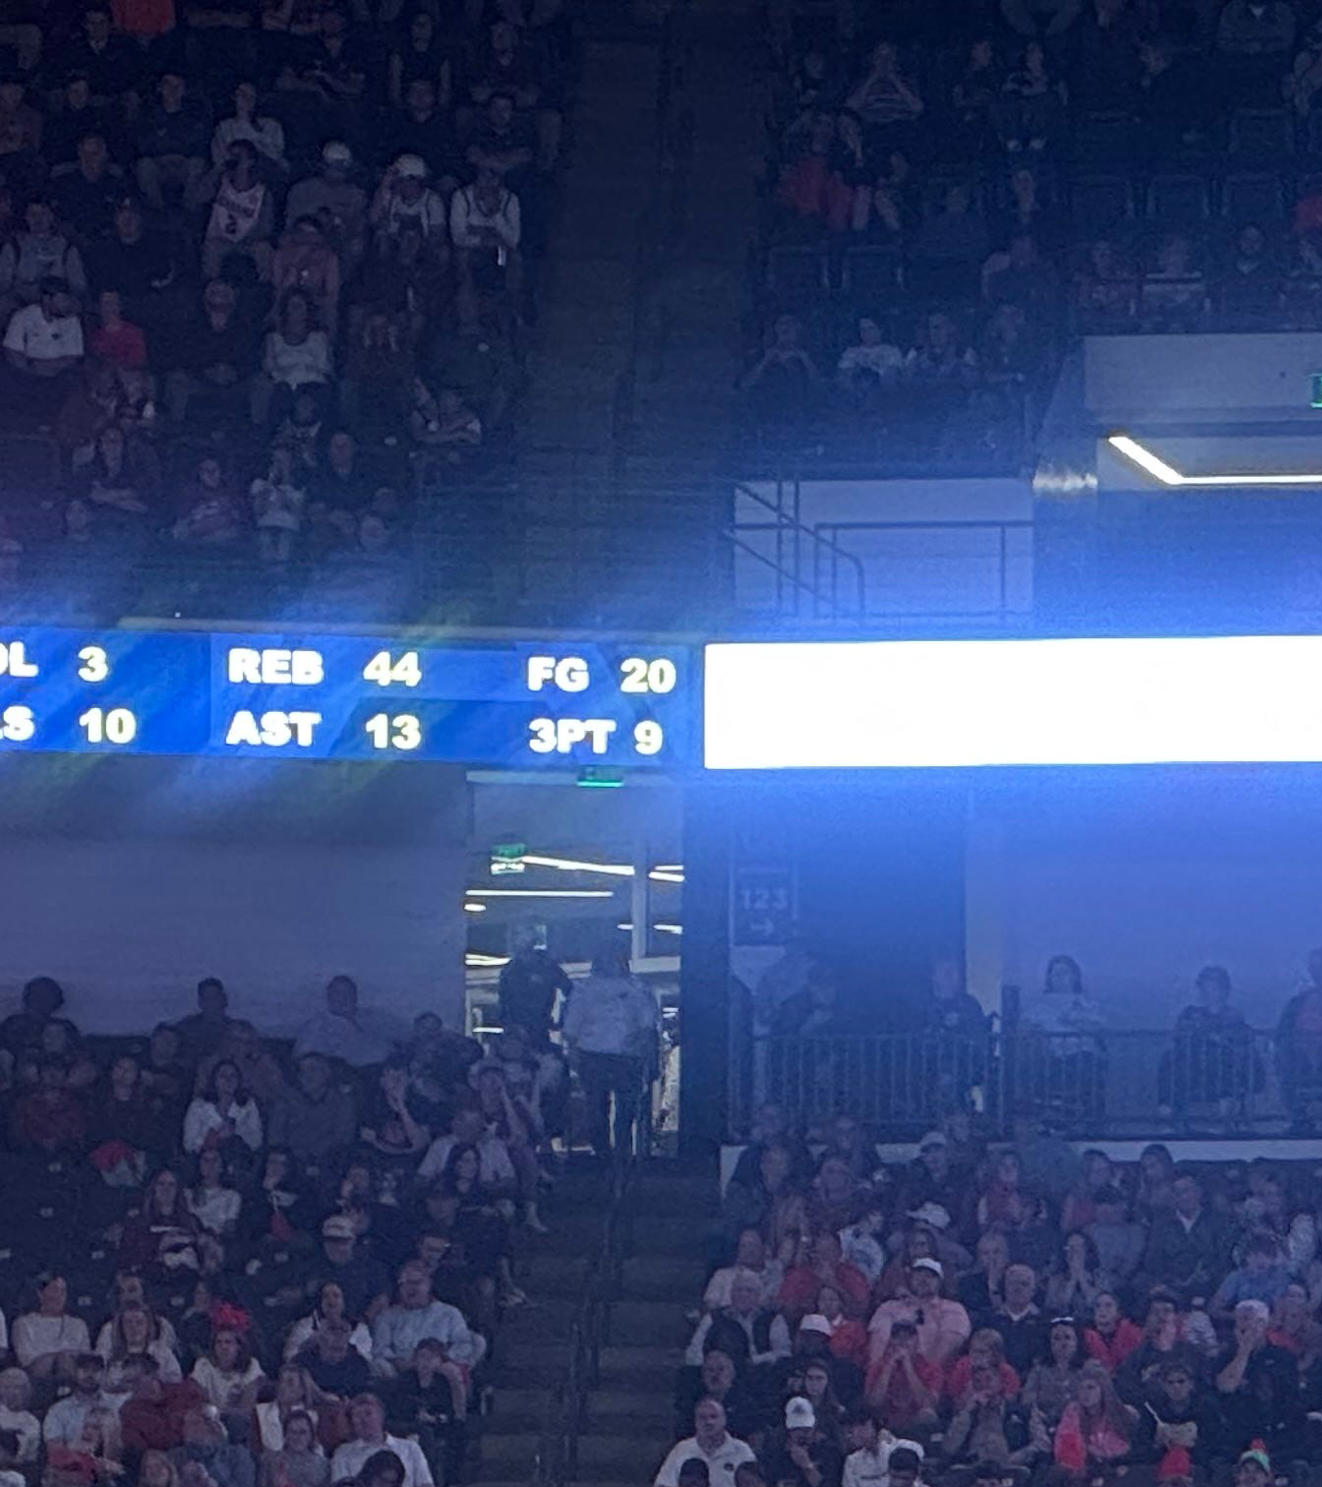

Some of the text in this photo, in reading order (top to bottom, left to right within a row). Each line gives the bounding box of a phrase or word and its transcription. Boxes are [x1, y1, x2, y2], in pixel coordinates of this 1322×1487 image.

[78, 646, 108, 682] 3
[228, 648, 422, 687] REB 44
[528, 656, 676, 693] FG 20
[79, 707, 136, 743] 10
[225, 710, 421, 750] AST 13
[529, 718, 663, 755] 3PT 9
